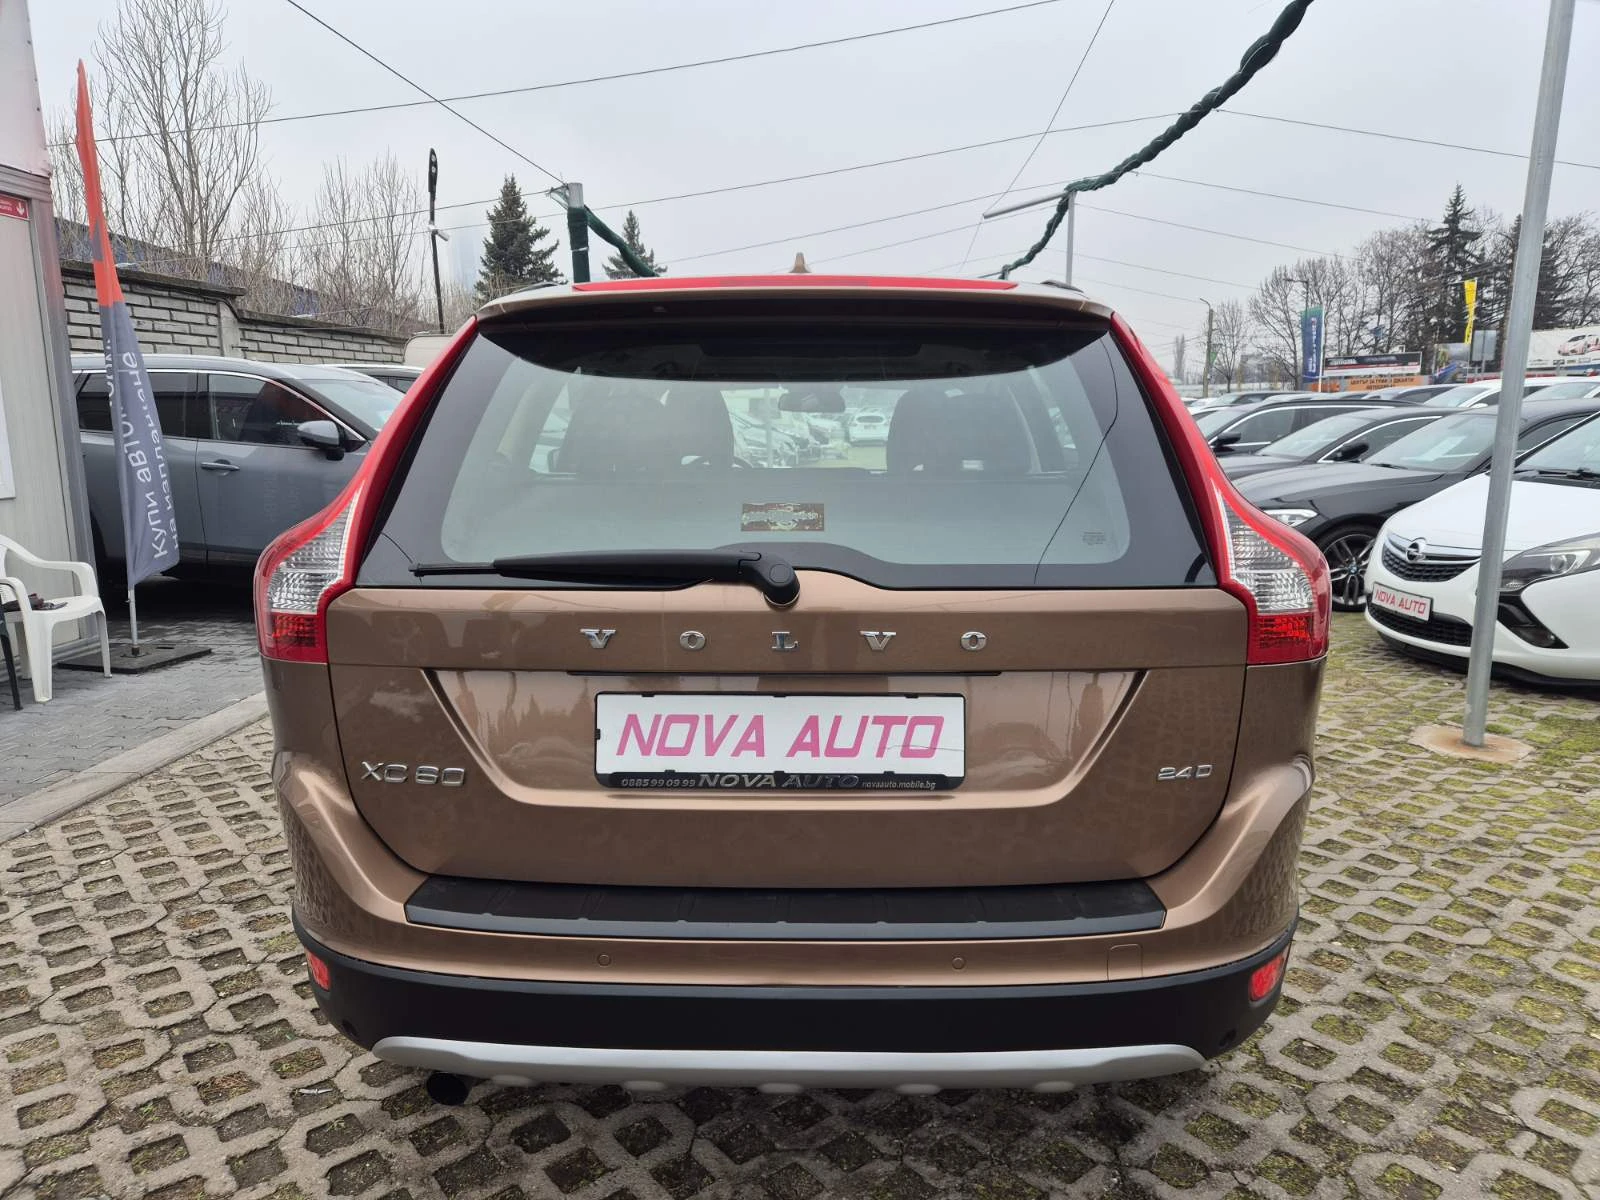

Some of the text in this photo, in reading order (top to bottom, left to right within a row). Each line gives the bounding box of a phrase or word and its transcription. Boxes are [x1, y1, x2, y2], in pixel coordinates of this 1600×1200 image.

[1375, 589, 1427, 615] NOVA AUTO
[580, 628, 988, 652] VOLVO
[616, 714, 945, 758] NOVA AUTO
[698, 774, 777, 788] NOVA
[781, 774, 860, 788] AUTO
